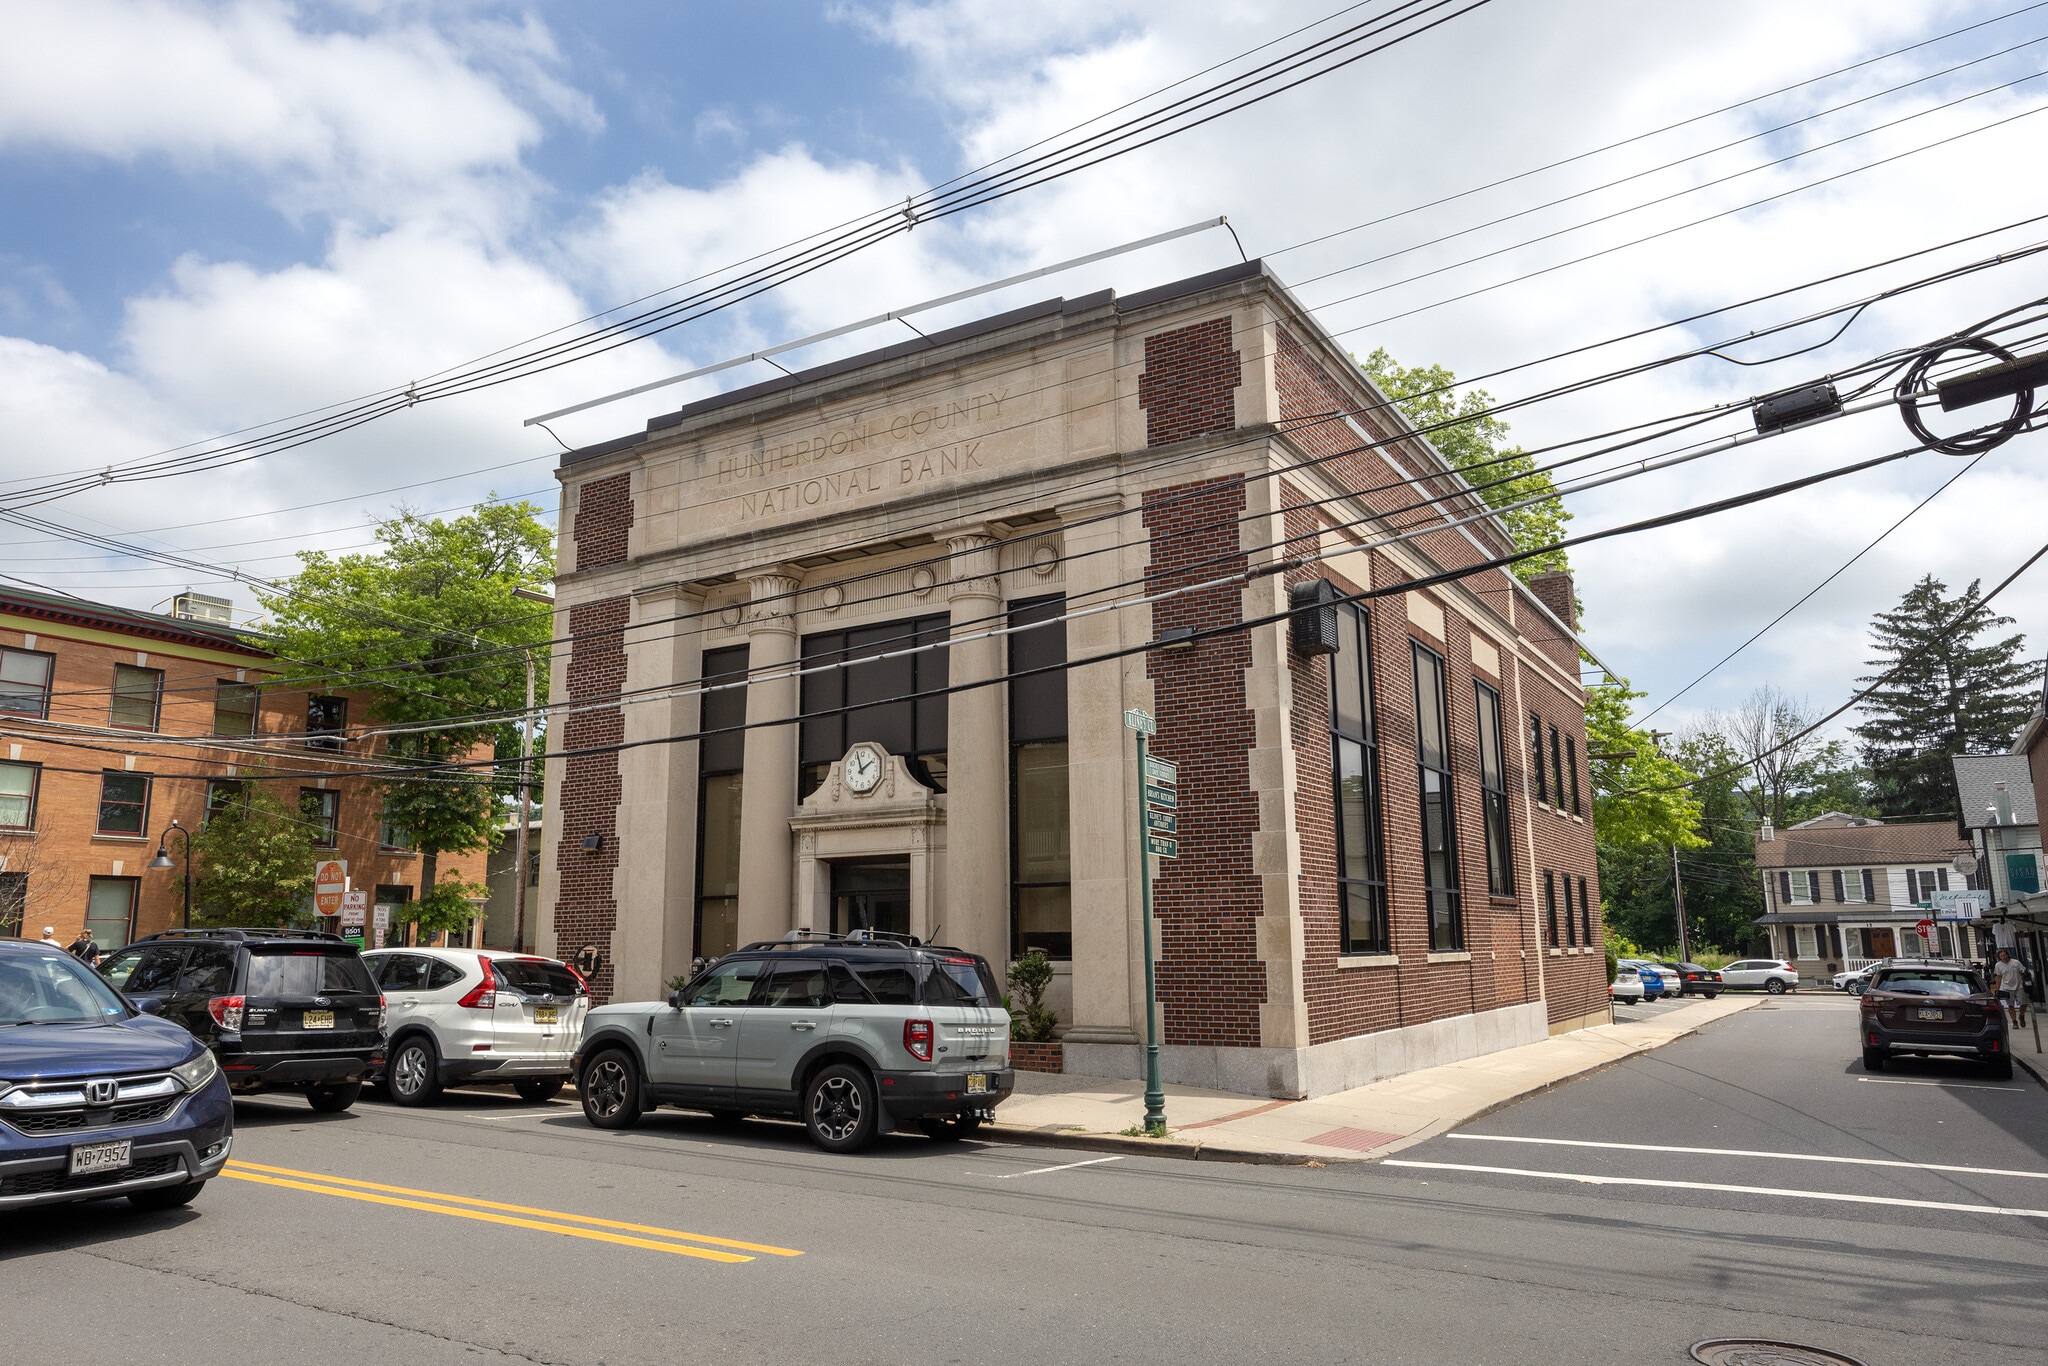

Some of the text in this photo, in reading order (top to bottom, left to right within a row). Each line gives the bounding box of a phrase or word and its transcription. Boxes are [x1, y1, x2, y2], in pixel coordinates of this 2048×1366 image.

[718, 389, 1010, 484] HUNTERDON COUNTY
[740, 442, 983, 520] NATIONAL BANK
[320, 872, 342, 881] DO NOT
[321, 896, 339, 905] ENTER
